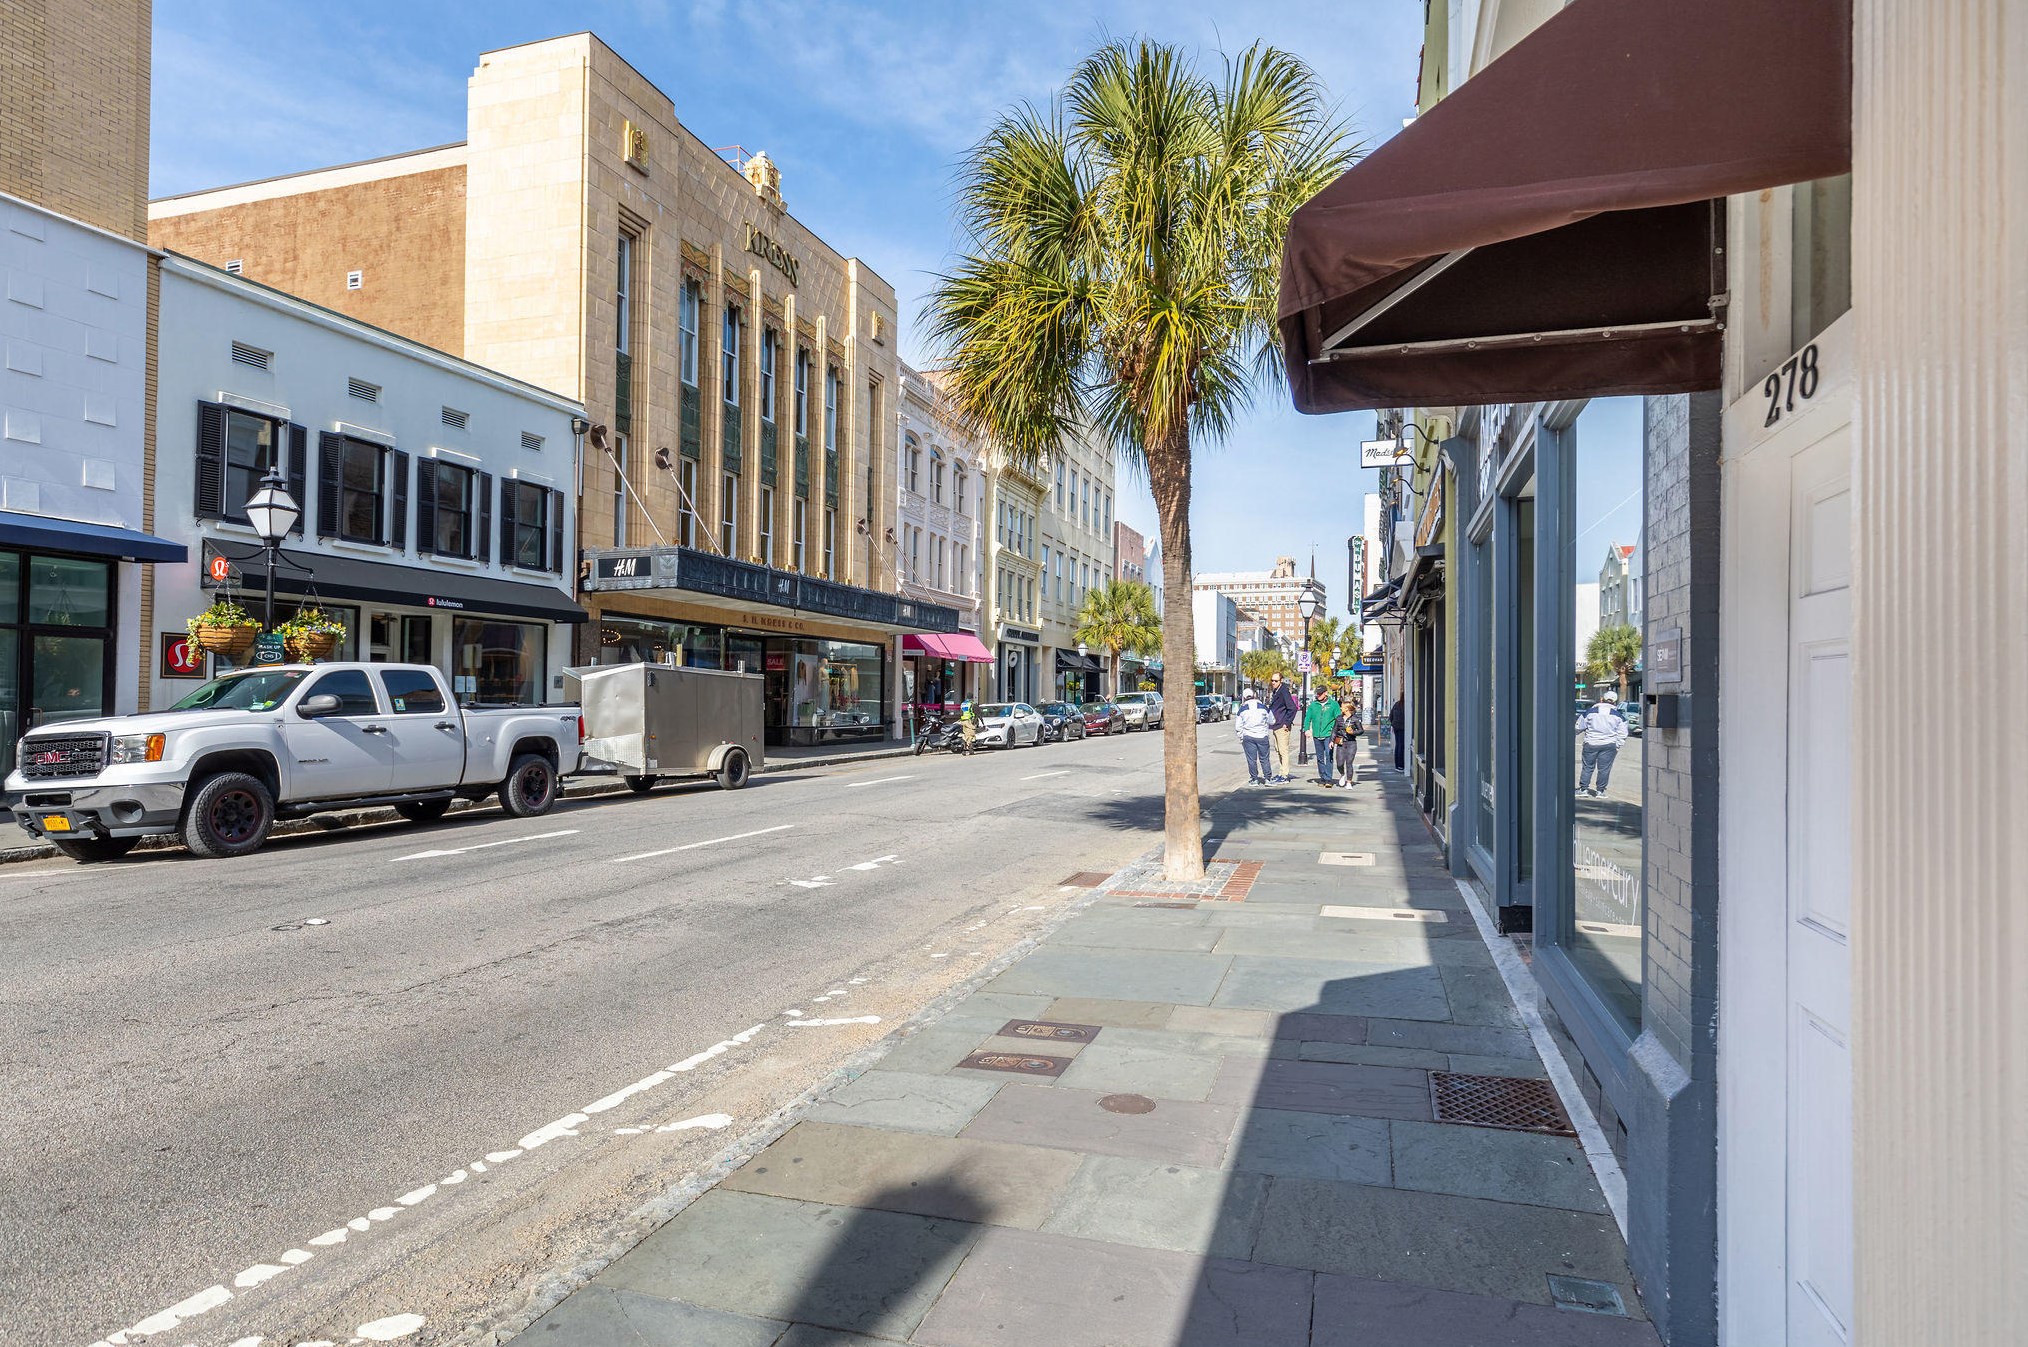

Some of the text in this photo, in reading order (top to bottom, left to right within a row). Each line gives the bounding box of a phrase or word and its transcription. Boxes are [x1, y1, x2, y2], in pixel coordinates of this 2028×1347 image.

[744, 220, 799, 288] KRESS
[1763, 344, 1819, 428] 278
[613, 558, 637, 577] H&M
[436, 598, 464, 609] lululemon
[760, 617, 786, 629] KRESS
[767, 658, 784, 666] SALE
[35, 750, 71, 765] GMC
